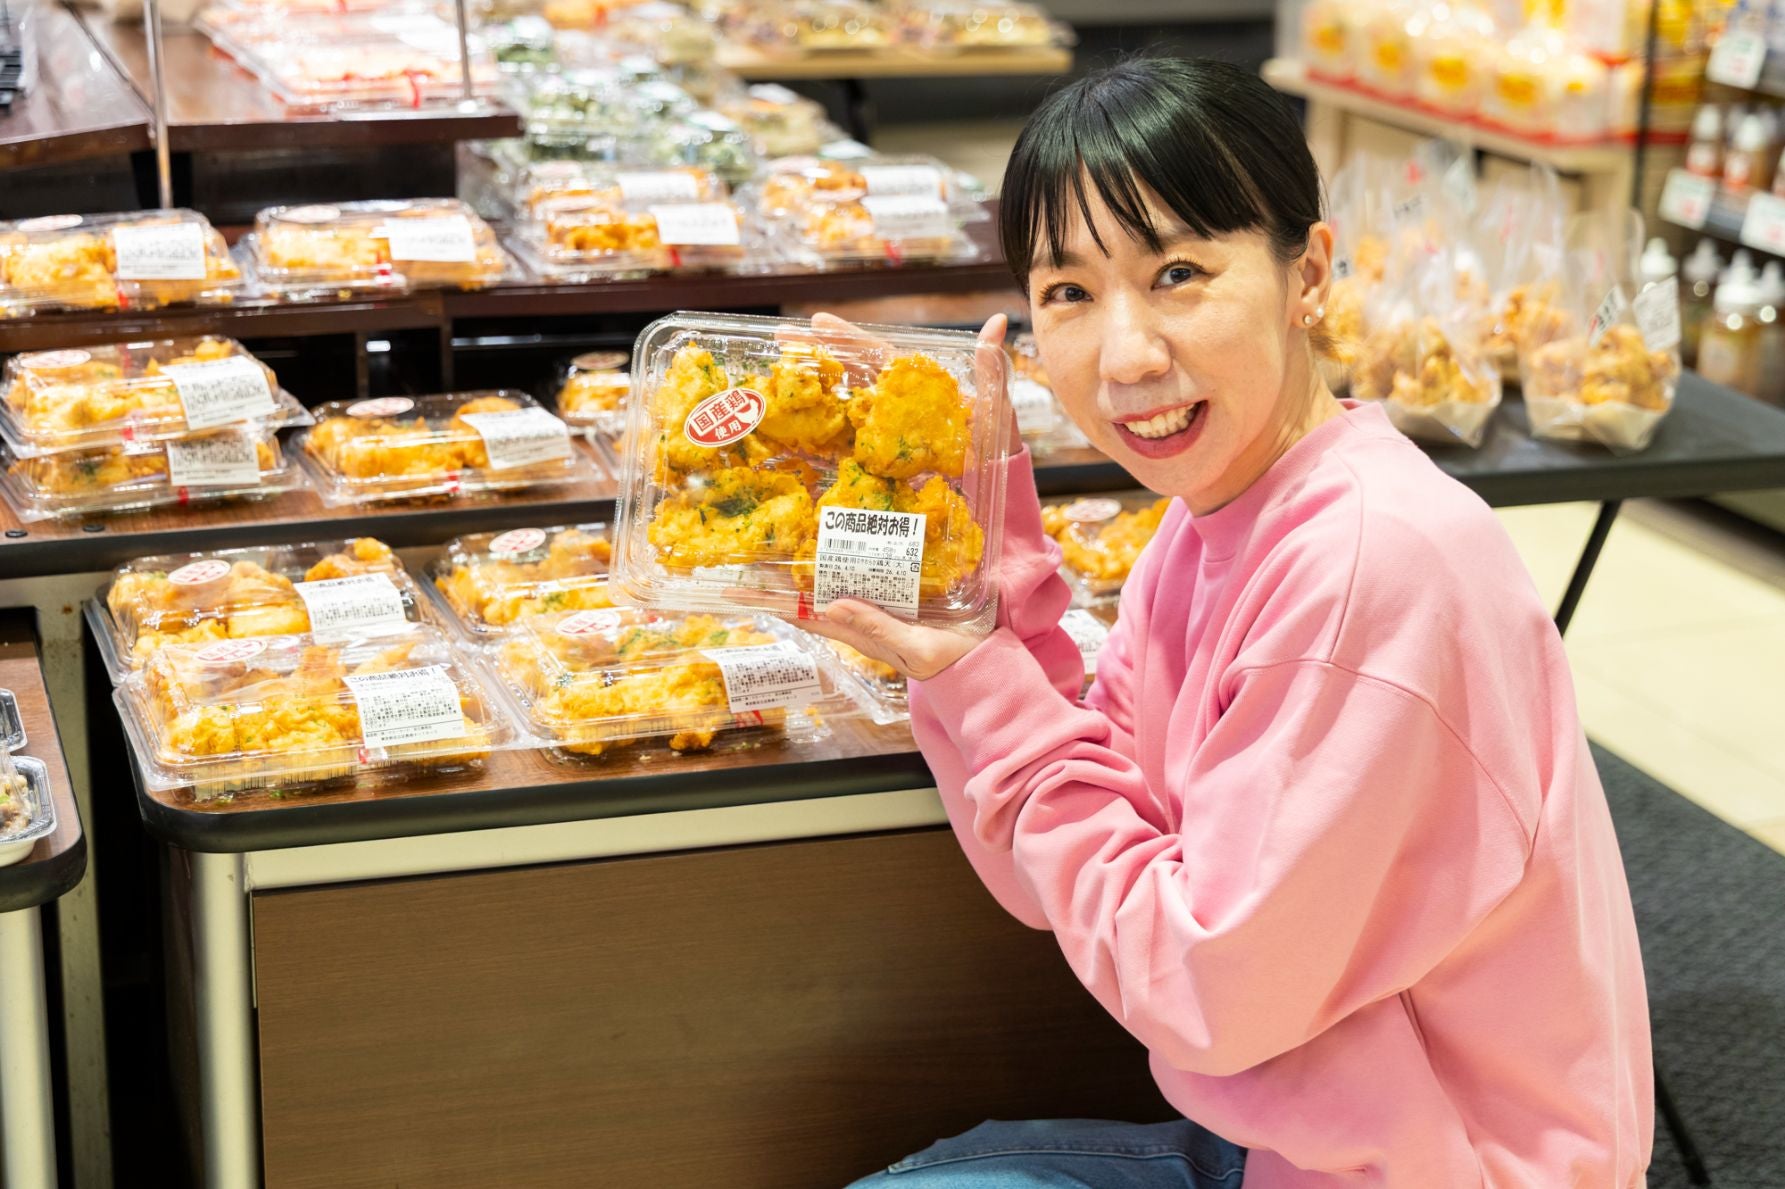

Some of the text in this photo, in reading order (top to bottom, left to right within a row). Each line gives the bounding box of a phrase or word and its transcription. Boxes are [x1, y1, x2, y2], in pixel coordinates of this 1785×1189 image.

[695, 390, 745, 431] 国産鶏
[714, 419, 742, 440] 使用
[825, 511, 919, 538] この商品絶対お得！
[906, 547, 919, 557] 632
